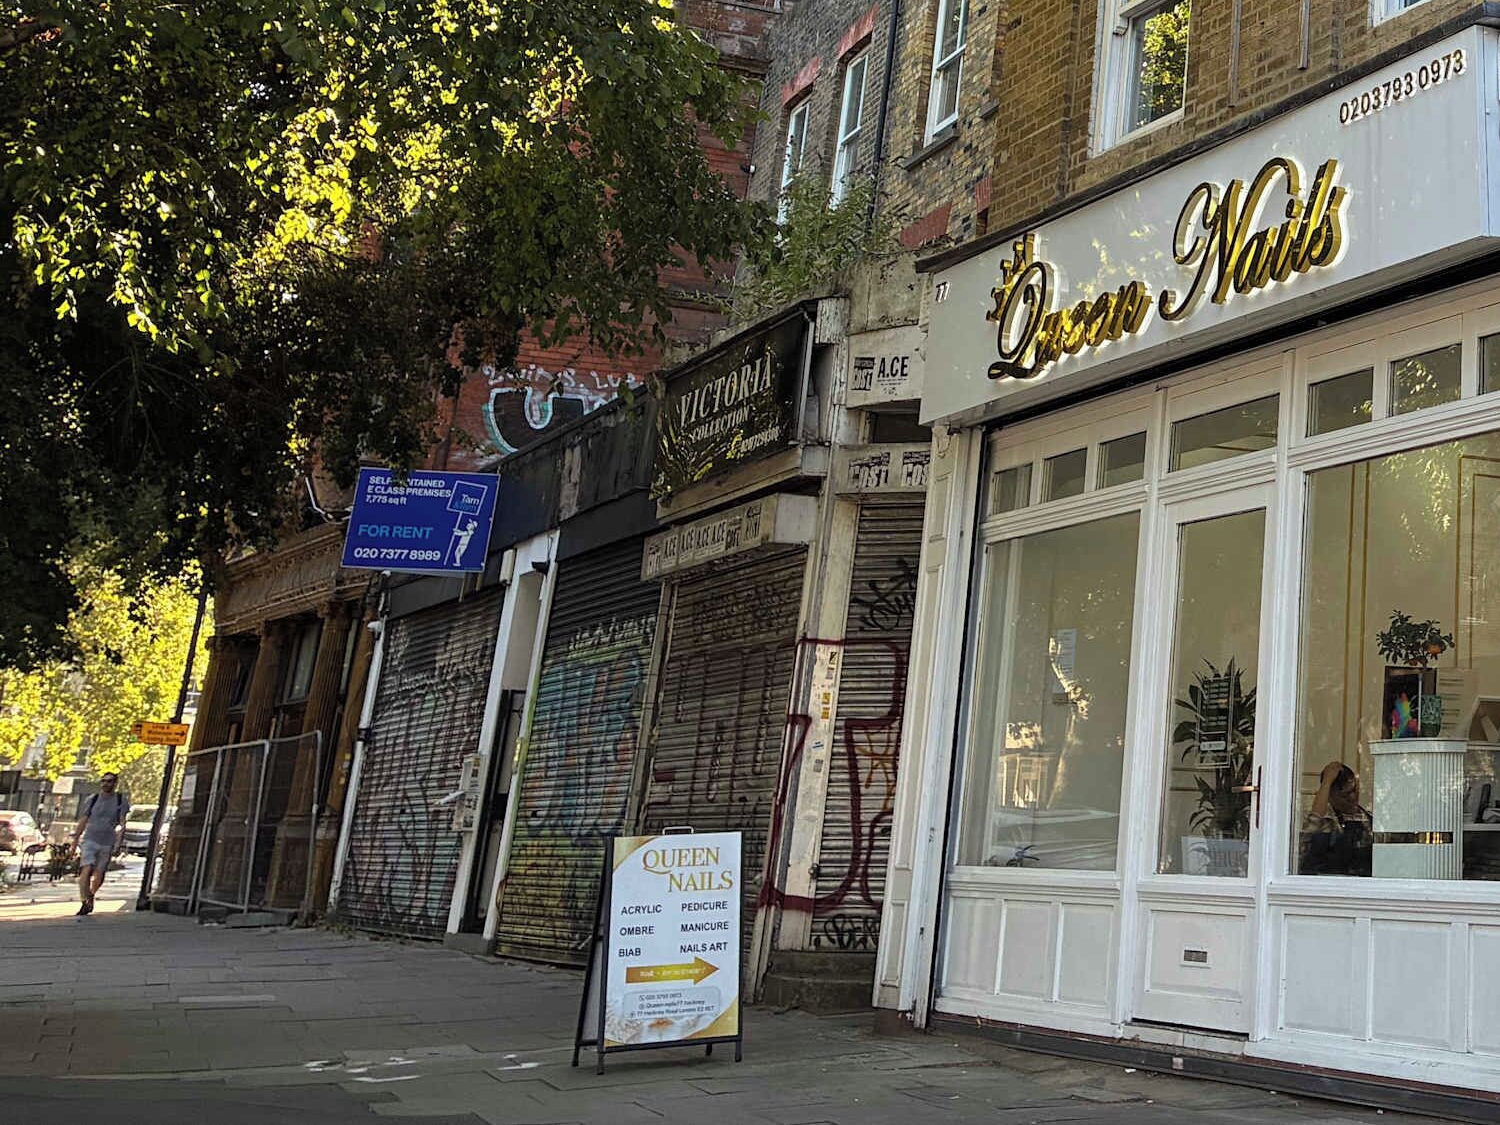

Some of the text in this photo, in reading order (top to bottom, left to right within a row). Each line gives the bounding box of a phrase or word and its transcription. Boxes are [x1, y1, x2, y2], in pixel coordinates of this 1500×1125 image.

[1418, 49, 1464, 89] 0973
[988, 157, 1346, 380] Queen Nails
[877, 356, 910, 378] A.CE
[680, 355, 771, 429] VICTORIA
[689, 406, 750, 443] COLLECTION
[367, 485, 452, 498] E CLASS PREMISES
[365, 495, 387, 504] 7,775
[388, 497, 399, 506] sq
[357, 524, 434, 540] FOR RENT
[353, 547, 441, 561] 020 7377 8989
[642, 847, 720, 875] QUEEN
[668, 870, 733, 893] NAILS
[621, 904, 662, 915] ACRYLIC
[681, 901, 728, 912] PEDICURE
[620, 926, 655, 936] OMBRE
[680, 921, 729, 932] MANICURE
[618, 947, 641, 957] BIAB
[680, 942, 728, 953] NAILS ART
